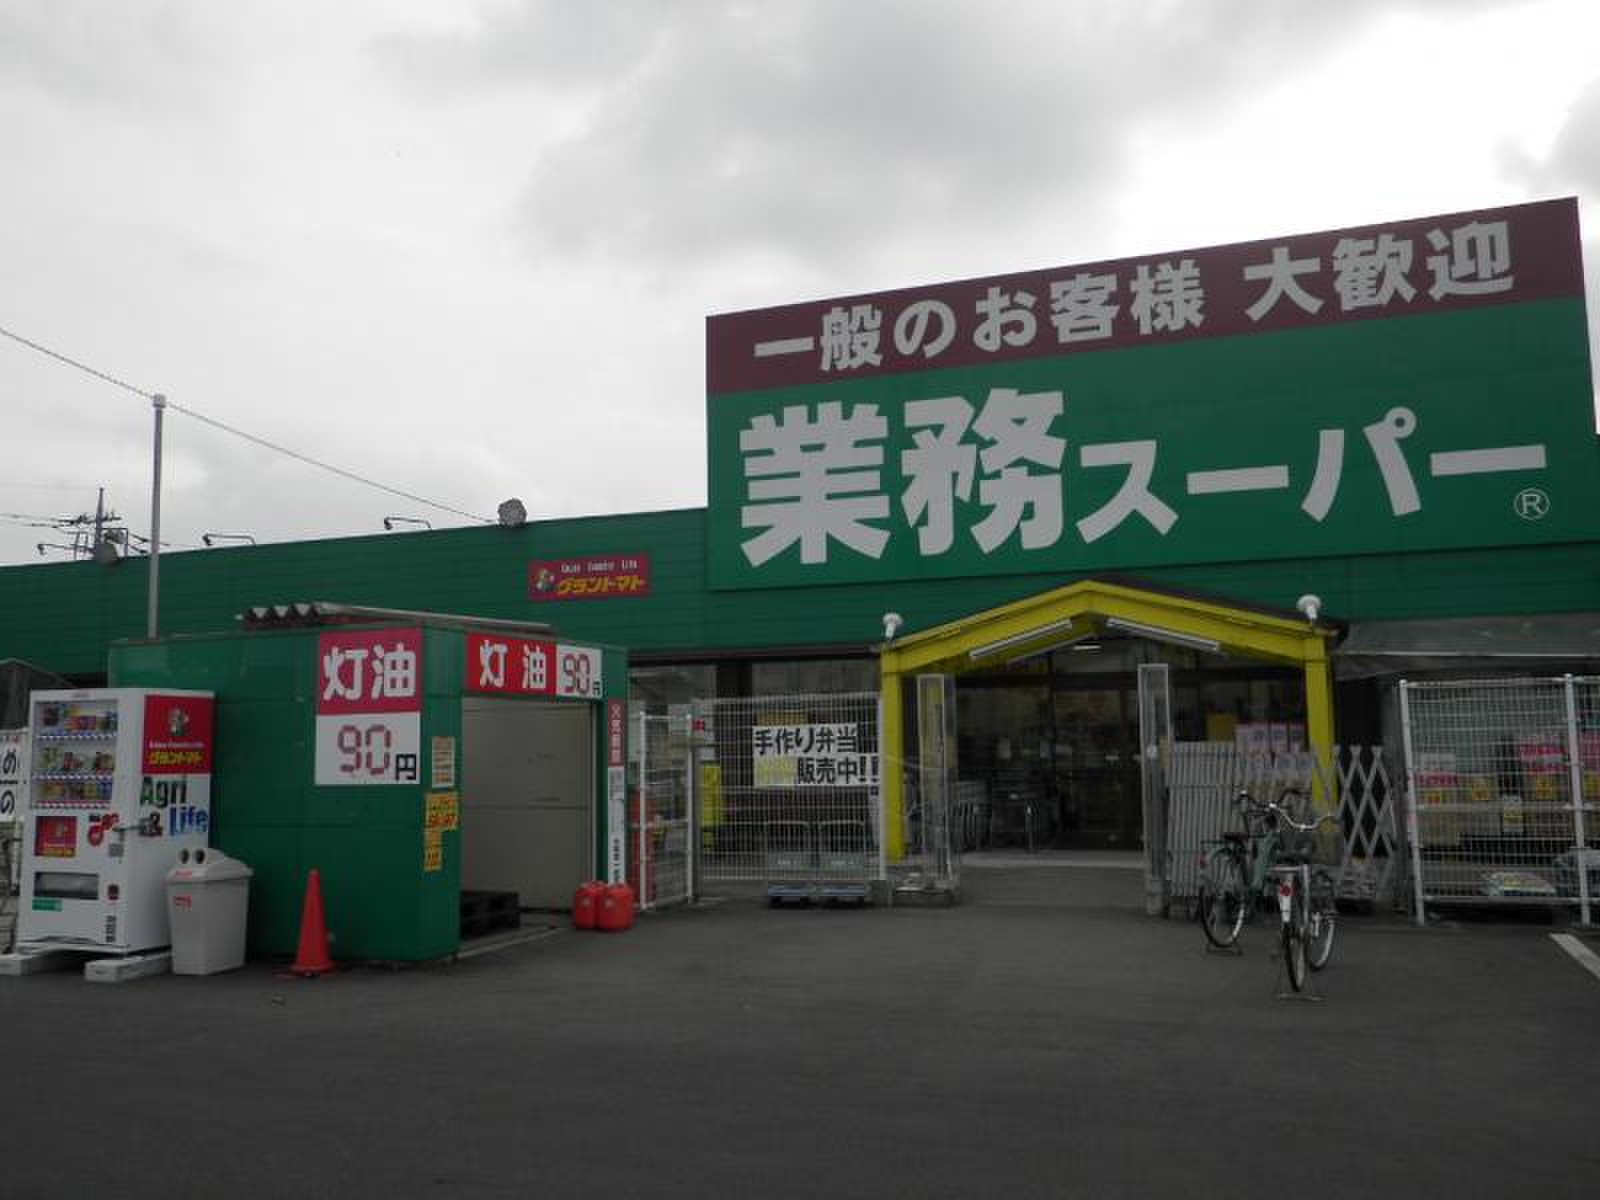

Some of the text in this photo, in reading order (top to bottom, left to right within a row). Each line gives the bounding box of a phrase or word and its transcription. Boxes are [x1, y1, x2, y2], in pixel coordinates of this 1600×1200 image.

[754, 221, 1514, 374] 一般のお客様 大歓迎
[739, 387, 1547, 568] 業務スーパー
[322, 642, 417, 700] 灯油
[479, 639, 547, 689] 灯油
[754, 726, 858, 755] 手作り弁当
[139, 775, 187, 808] Agri
